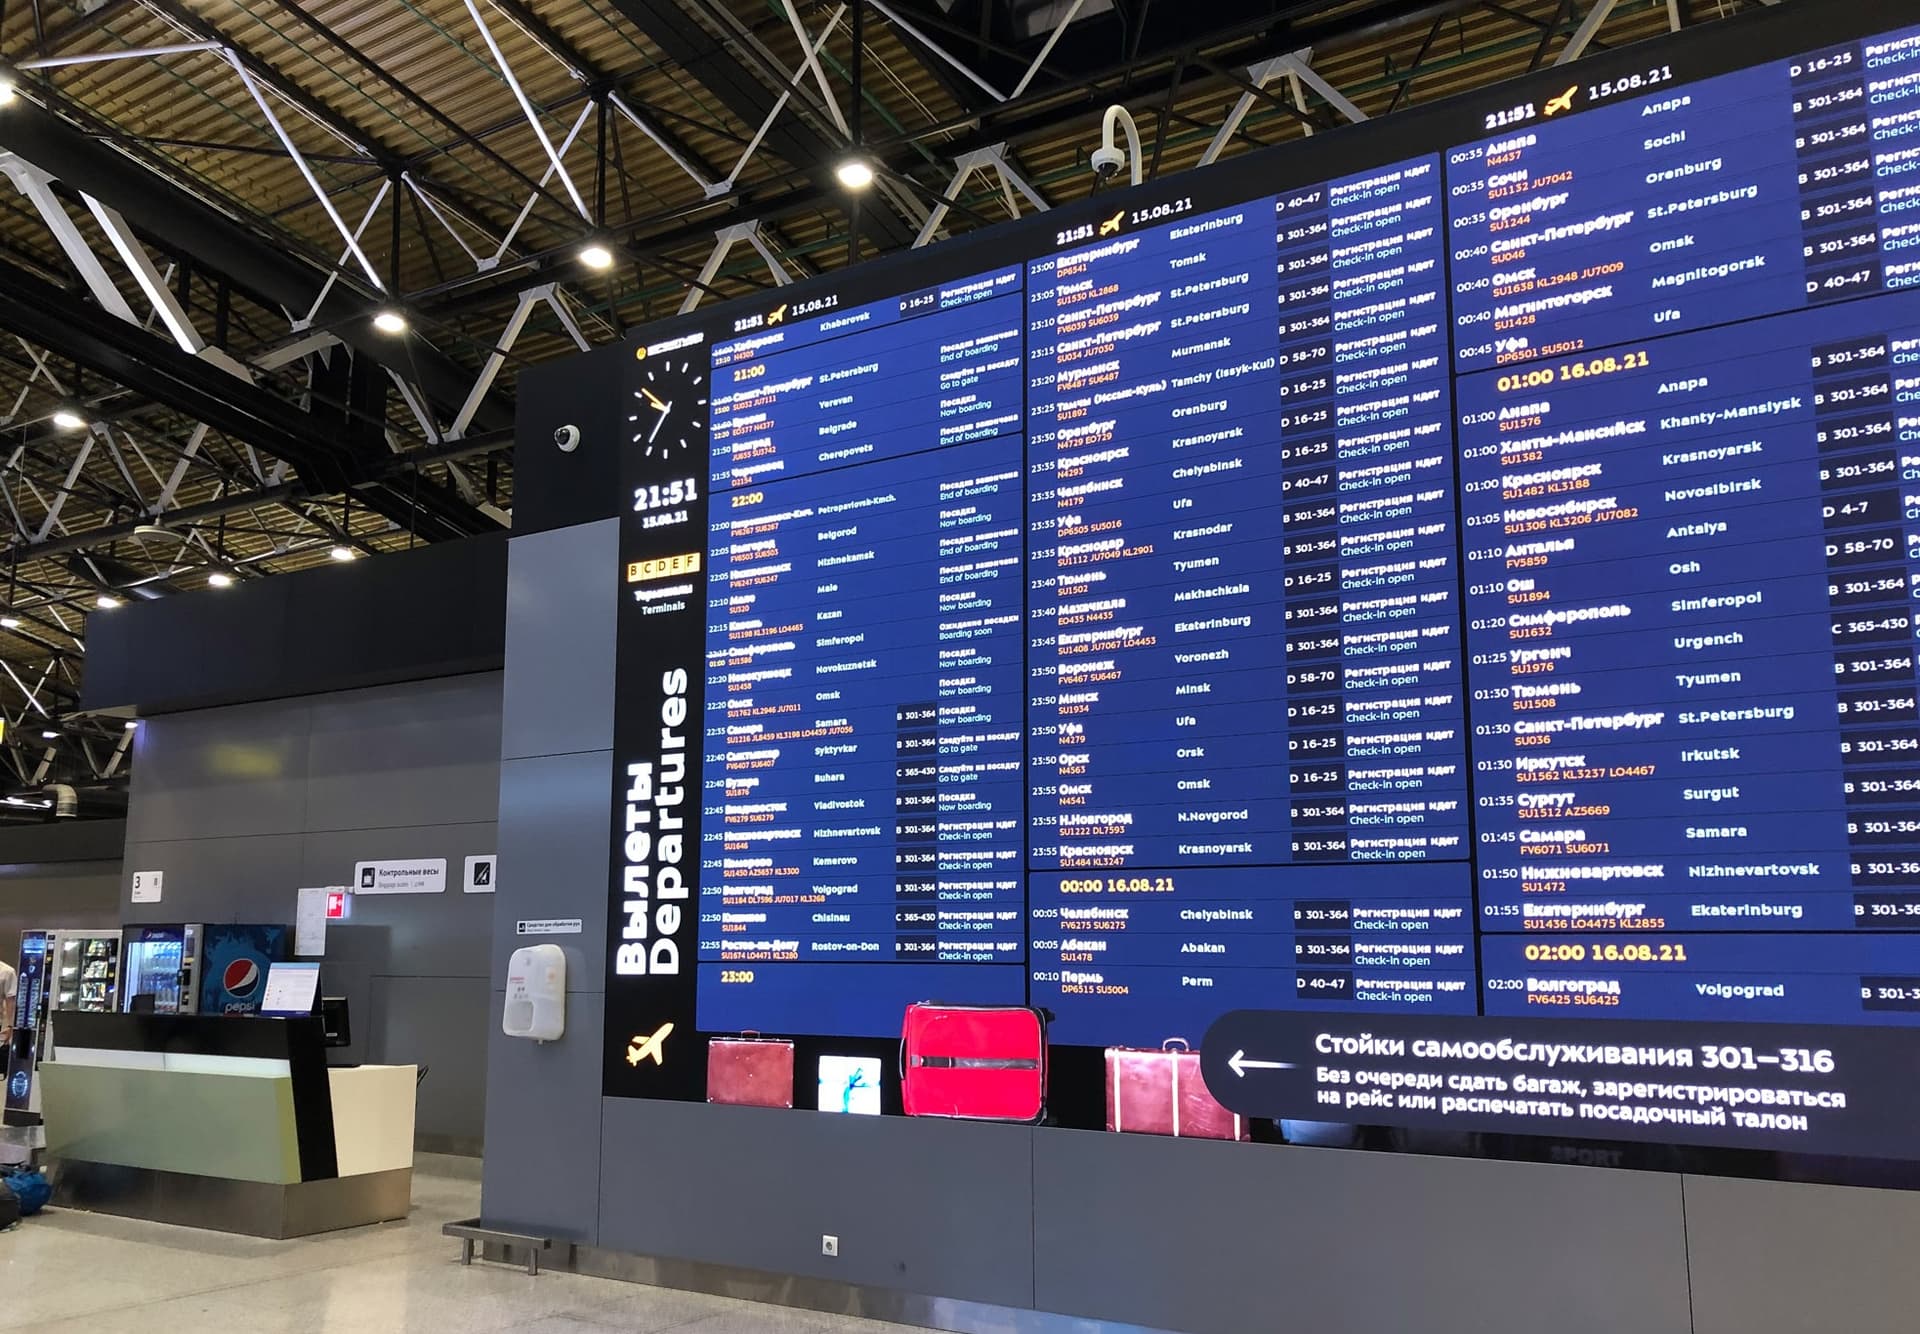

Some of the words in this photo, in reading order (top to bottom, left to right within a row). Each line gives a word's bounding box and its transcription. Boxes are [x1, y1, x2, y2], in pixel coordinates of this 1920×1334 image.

[1790, 65, 1802, 77] D
[1808, 53, 1852, 72] 16-25
[1589, 66, 1672, 100] 15.08.21
[1642, 95, 1690, 117] Anapa
[1485, 103, 1536, 130] 21:51
[1450, 148, 1483, 165] 00:35
[1486, 133, 1537, 157] Анапа
[1644, 130, 1686, 150] Sochi
[1487, 169, 1528, 188] Сочи
[1646, 157, 1722, 184] Orenburg
[1131, 198, 1192, 223] 15.08.21
[1489, 191, 1569, 221] Оренбург
[1647, 184, 1758, 219] St.Petersburg
[1170, 213, 1243, 241] Ekaterinburg
[1455, 244, 1488, 260] 00:40
[1490, 210, 1634, 252] Санкт-Петербург
[1649, 234, 1695, 253] Omsk
[1170, 252, 1206, 269] Tomsk
[1492, 268, 1536, 286] Омск
[1652, 254, 1765, 288] Magnitogorsk
[1494, 284, 1612, 319] Магнитогорск
[1654, 308, 1680, 323] Ufa
[1171, 335, 1231, 358] Murmansk
[1459, 343, 1492, 359] 00:45
[1494, 336, 1528, 354] Уфа
[1172, 373, 1212, 390] Tamchy
[1215, 356, 1275, 380] (Issyk-Kul)
[1497, 370, 1553, 392] 01:00
[1560, 352, 1649, 382] 16.08.21
[1658, 376, 1708, 394] Anapa
[1172, 399, 1227, 419] Orenburg
[1499, 401, 1550, 420] Анапа
[1660, 397, 1801, 430] Khanty-Mansiysk
[1172, 426, 1244, 448] Krasnoyarsk
[1500, 419, 1646, 454] Ханты-Мансийск
[1662, 440, 1762, 465] Krasnoyarsk
[1502, 463, 1602, 489] Красноярск
[633, 477, 697, 511] 21:51
[1665, 479, 1762, 501] Novosibirsk
[1504, 497, 1617, 523] Новосибирск
[1822, 506, 1835, 517] D
[1841, 502, 1868, 516] 4-7
[1174, 522, 1233, 540] Krasnodar
[1667, 520, 1727, 538] Antalya
[1468, 547, 1502, 561] 01:10
[1505, 538, 1575, 558] Анталья
[631, 566, 637, 576] B
[644, 563, 651, 573] C
[659, 561, 665, 571] D
[673, 559, 679, 568] E
[688, 556, 693, 566] F
[1174, 556, 1219, 572] Tyumen
[1507, 579, 1534, 593] Ош
[642, 600, 685, 615] Terminals
[1671, 592, 1762, 613] Simferopol
[1509, 604, 1631, 630] Симферополь
[1832, 624, 1842, 634] C
[1848, 617, 1908, 633] 365-430
[1674, 632, 1743, 650] Urgench
[1175, 649, 1229, 665] Voronezh
[1510, 645, 1571, 664] Ургенч
[1676, 670, 1741, 688] Tyumen
[1176, 683, 1211, 696] Minsk
[1512, 682, 1581, 698] Тюмень
[1678, 705, 1794, 724] St.Petersburg
[1838, 702, 1848, 713] B
[1855, 698, 1914, 712] 301-364
[1514, 711, 1664, 736] Санкт-Петербург
[1177, 746, 1204, 759] Orsk
[1681, 747, 1740, 762] Irkutsk
[1516, 752, 1586, 772] Иркутск
[1518, 791, 1575, 808] Сургут
[1684, 786, 1739, 801] Surgut
[649, 668, 689, 975] Departures
[1059, 812, 1133, 826] Н.Новгород
[1178, 808, 1248, 823] N.Novgorod
[1520, 828, 1586, 844] Самара
[1686, 825, 1747, 839] Samara
[379, 868, 420, 878] Контрольные
[422, 868, 439, 876] весы
[616, 762, 653, 975] Вылеты
[1483, 867, 1518, 880] 01:50
[1521, 863, 1664, 880] Нижневартовск
[1689, 862, 1820, 878] Nizhnevartovsk
[134, 875, 141, 888] 3
[1060, 879, 1102, 893] 00:00
[1108, 878, 1174, 892] 16.08.21
[1060, 907, 1129, 920] Челябинск
[1180, 908, 1253, 921] Chelyabinsk
[1523, 901, 1645, 919] Екатеринбург
[1691, 903, 1803, 918] Ekaterinburg
[1061, 938, 1106, 952] Абакан
[1181, 942, 1225, 954] Abakan
[1525, 945, 1585, 961] 02:00
[1592, 944, 1686, 961] 16.08.21
[1061, 970, 1103, 985] Пермь
[1182, 975, 1213, 988] Perm
[1297, 978, 1305, 988] D
[1310, 977, 1345, 989] 40-47
[1356, 979, 1432, 992] Регистрация
[1436, 980, 1465, 992] идет
[1488, 978, 1523, 990] 02:00
[1527, 978, 1620, 996] Волгоград
[1696, 983, 1784, 998] Volgograd
[1356, 990, 1399, 1003] Check-in
[1402, 992, 1432, 1003] open
[225, 1001, 255, 1013] pepsi
[1314, 1032, 1406, 1058] Стойки
[1412, 1035, 1693, 1067] самообслуживания
[1316, 1066, 1351, 1084] Без
[1355, 1068, 1444, 1092] очереди
[1449, 1070, 1507, 1092] сдать
[1512, 1072, 1587, 1098] багаж,
[1593, 1078, 1846, 1109] зарегистрироваться
[1317, 1089, 1340, 1105] на
[1345, 1090, 1394, 1112] рейс
[1398, 1092, 1436, 1110] или
[1441, 1093, 1574, 1121] распечатать
[1580, 1098, 1726, 1128] посадочный
[1732, 1105, 1808, 1130] талон
